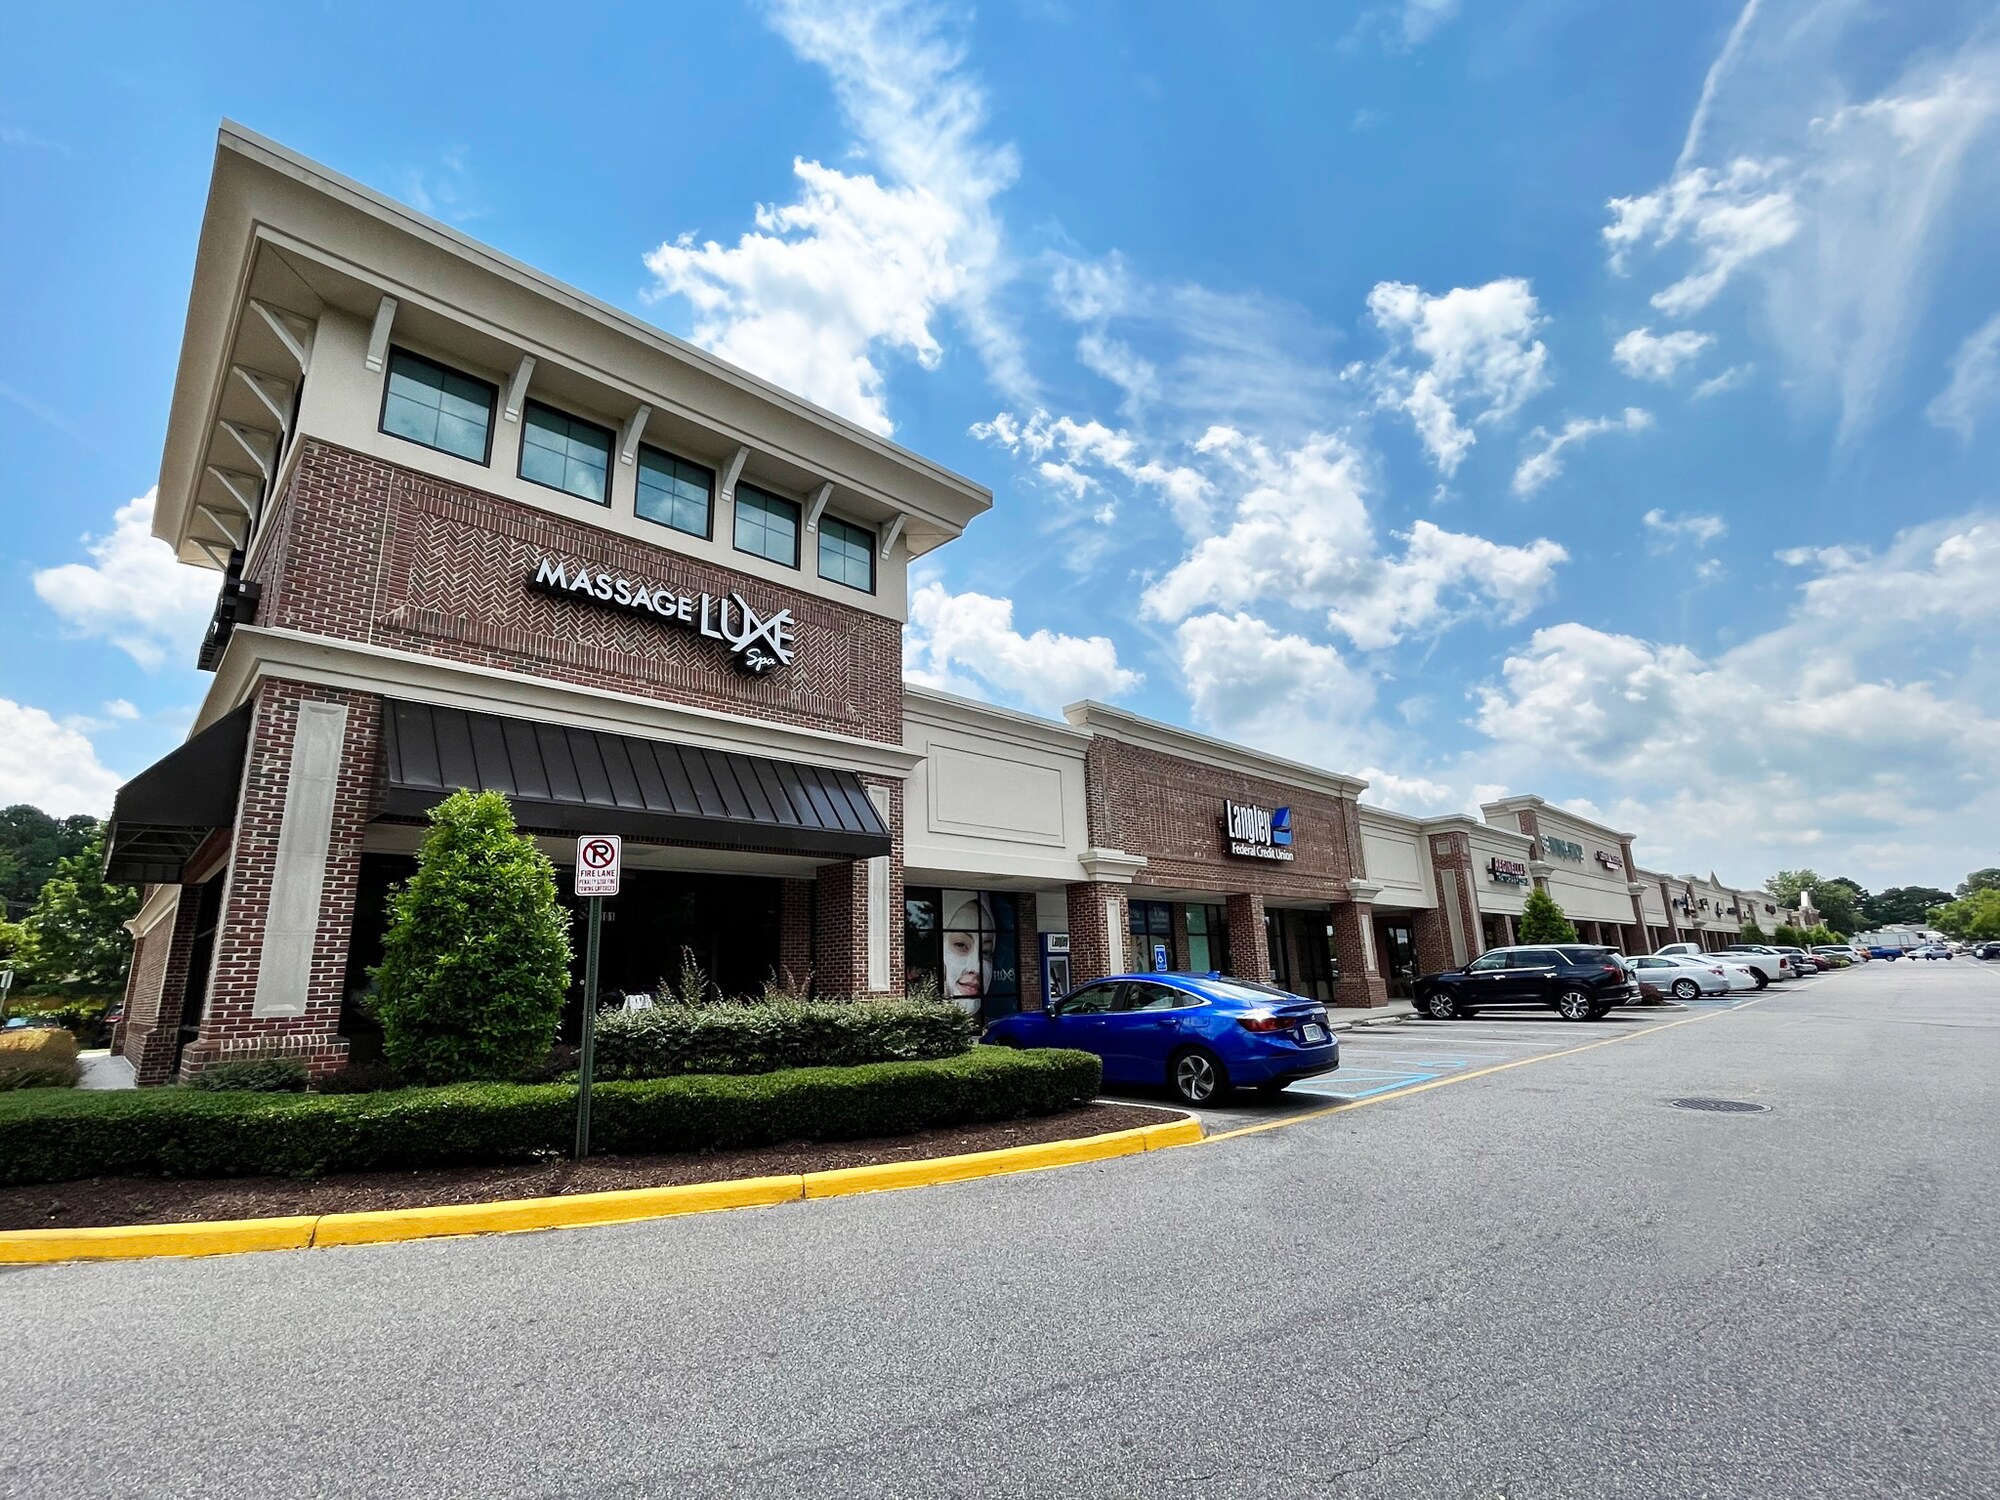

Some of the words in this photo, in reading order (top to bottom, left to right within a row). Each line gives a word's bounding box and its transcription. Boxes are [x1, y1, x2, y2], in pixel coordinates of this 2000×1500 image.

[536, 557, 693, 622] MASSAGE
[700, 592, 795, 666] LUXE
[746, 648, 776, 671] Spa
[1226, 799, 1271, 846] Langley
[1231, 842, 1256, 857] Federal
[1256, 845, 1276, 859] Credit
[1275, 848, 1294, 861] Union
